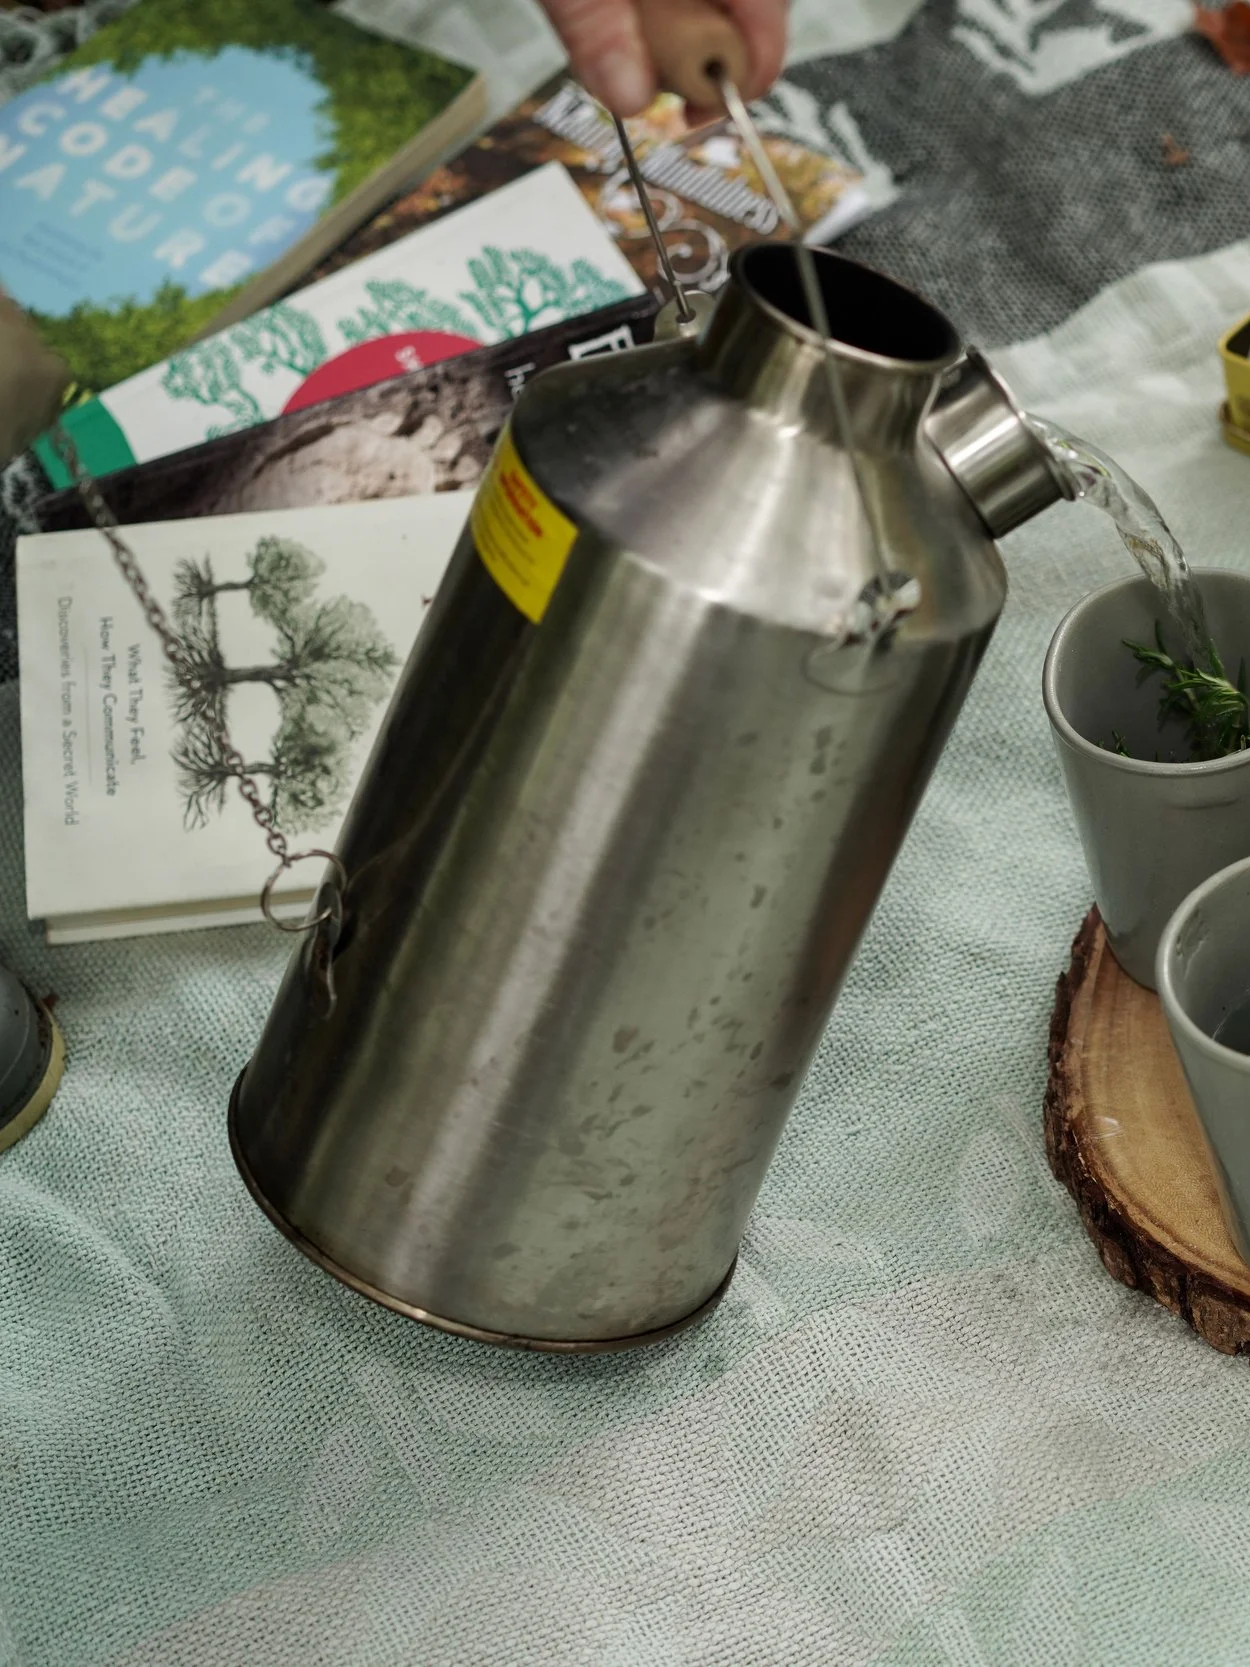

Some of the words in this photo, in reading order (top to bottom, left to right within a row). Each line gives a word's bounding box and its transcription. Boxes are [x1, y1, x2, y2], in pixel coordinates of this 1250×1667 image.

[57, 68, 331, 211] HEALING
[19, 102, 198, 200] CODE
[204, 192, 295, 246] OF
[57, 597, 74, 678] Discoveries
[99, 616, 113, 650] How
[99, 654, 116, 690] They
[127, 644, 142, 685] What
[61, 681, 76, 715] from
[126, 688, 143, 723] They
[62, 730, 79, 778] Secret
[103, 694, 120, 797] Communicate
[65, 782, 81, 826] World
